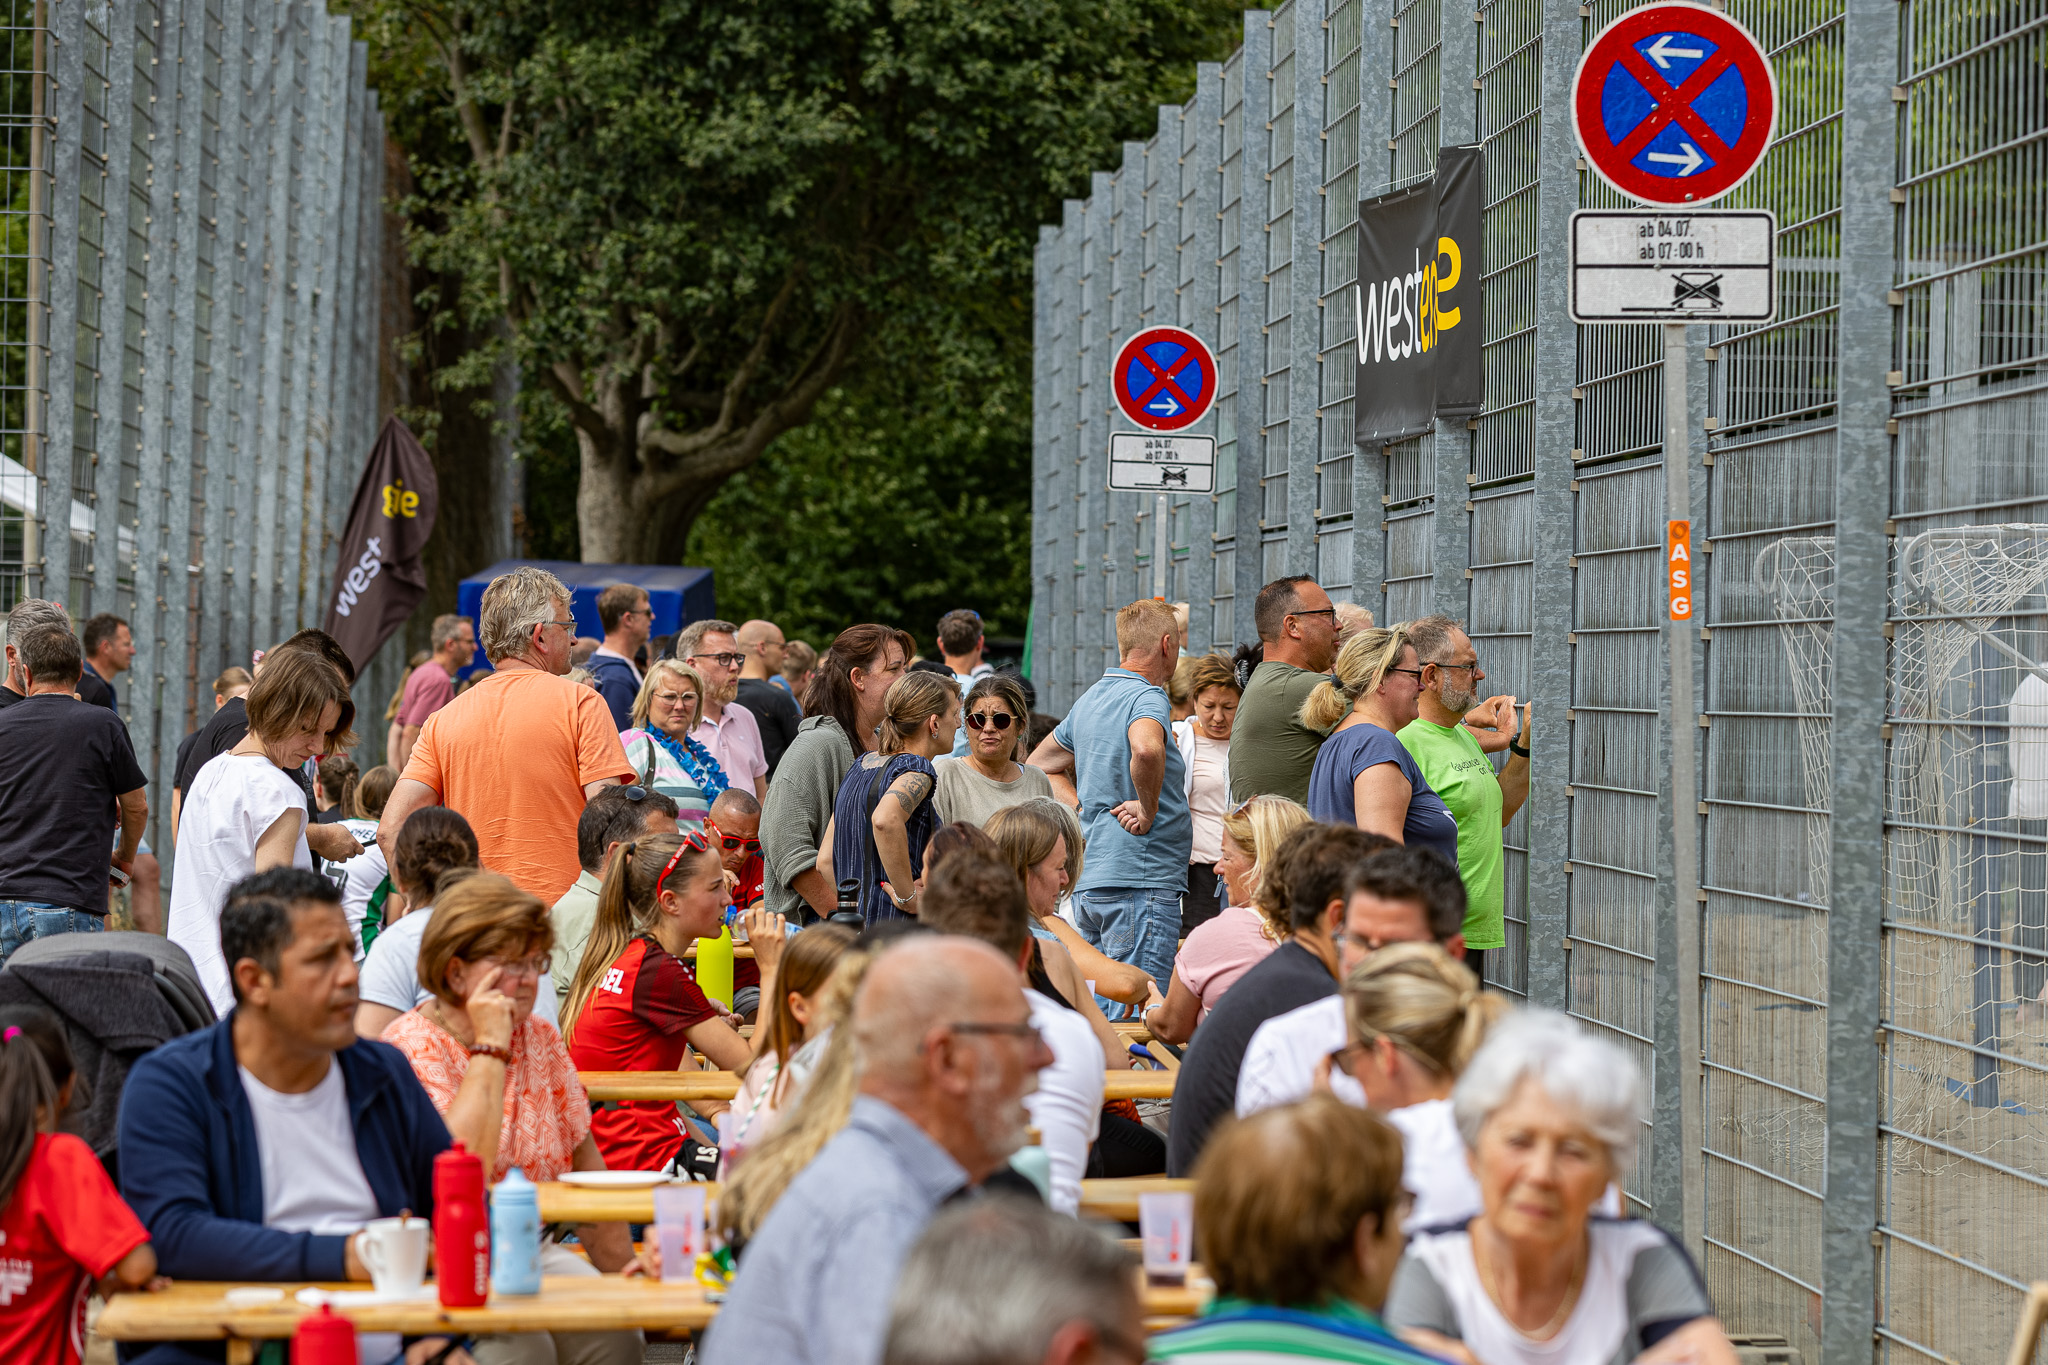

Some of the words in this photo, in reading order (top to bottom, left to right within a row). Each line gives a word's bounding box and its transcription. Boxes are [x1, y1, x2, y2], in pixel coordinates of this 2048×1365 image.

[1640, 221, 1654, 238] ab
[1658, 220, 1695, 237] 04.07.
[1640, 242, 1654, 259] ab
[1658, 242, 1693, 259] 07:00
[1696, 242, 1704, 258] h
[1145, 440, 1153, 449] ab
[1145, 451, 1153, 460] ab
[336, 536, 382, 617] west
